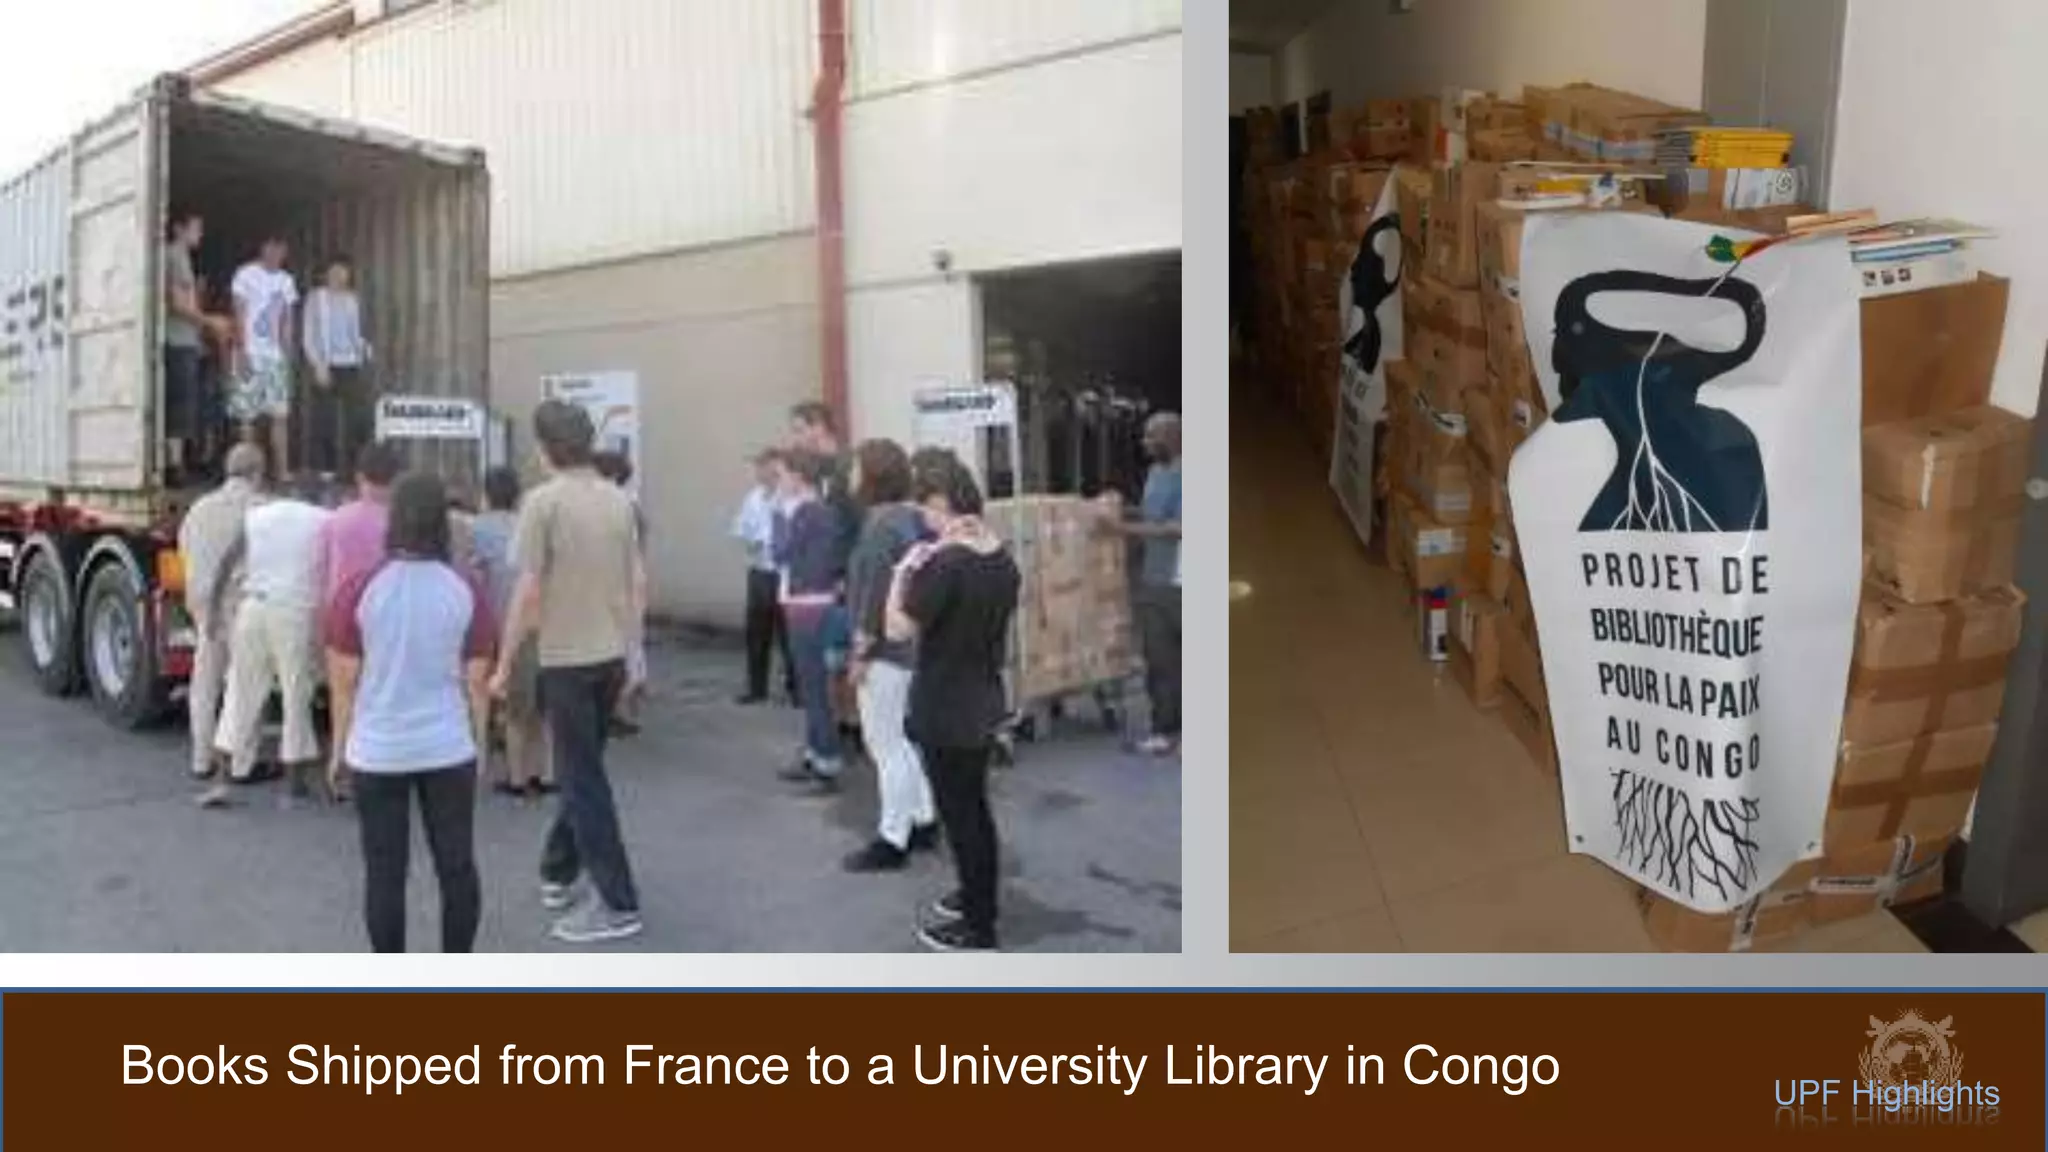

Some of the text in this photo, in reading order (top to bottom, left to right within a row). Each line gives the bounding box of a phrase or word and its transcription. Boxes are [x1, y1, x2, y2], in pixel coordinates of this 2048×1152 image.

[1581, 552, 1768, 595] PROJET DE
[1590, 607, 1764, 659] BIBLIOTHÈQUE
[1598, 662, 1760, 719] POUR LA PAIX
[1607, 715, 1760, 780] AU CONGO
